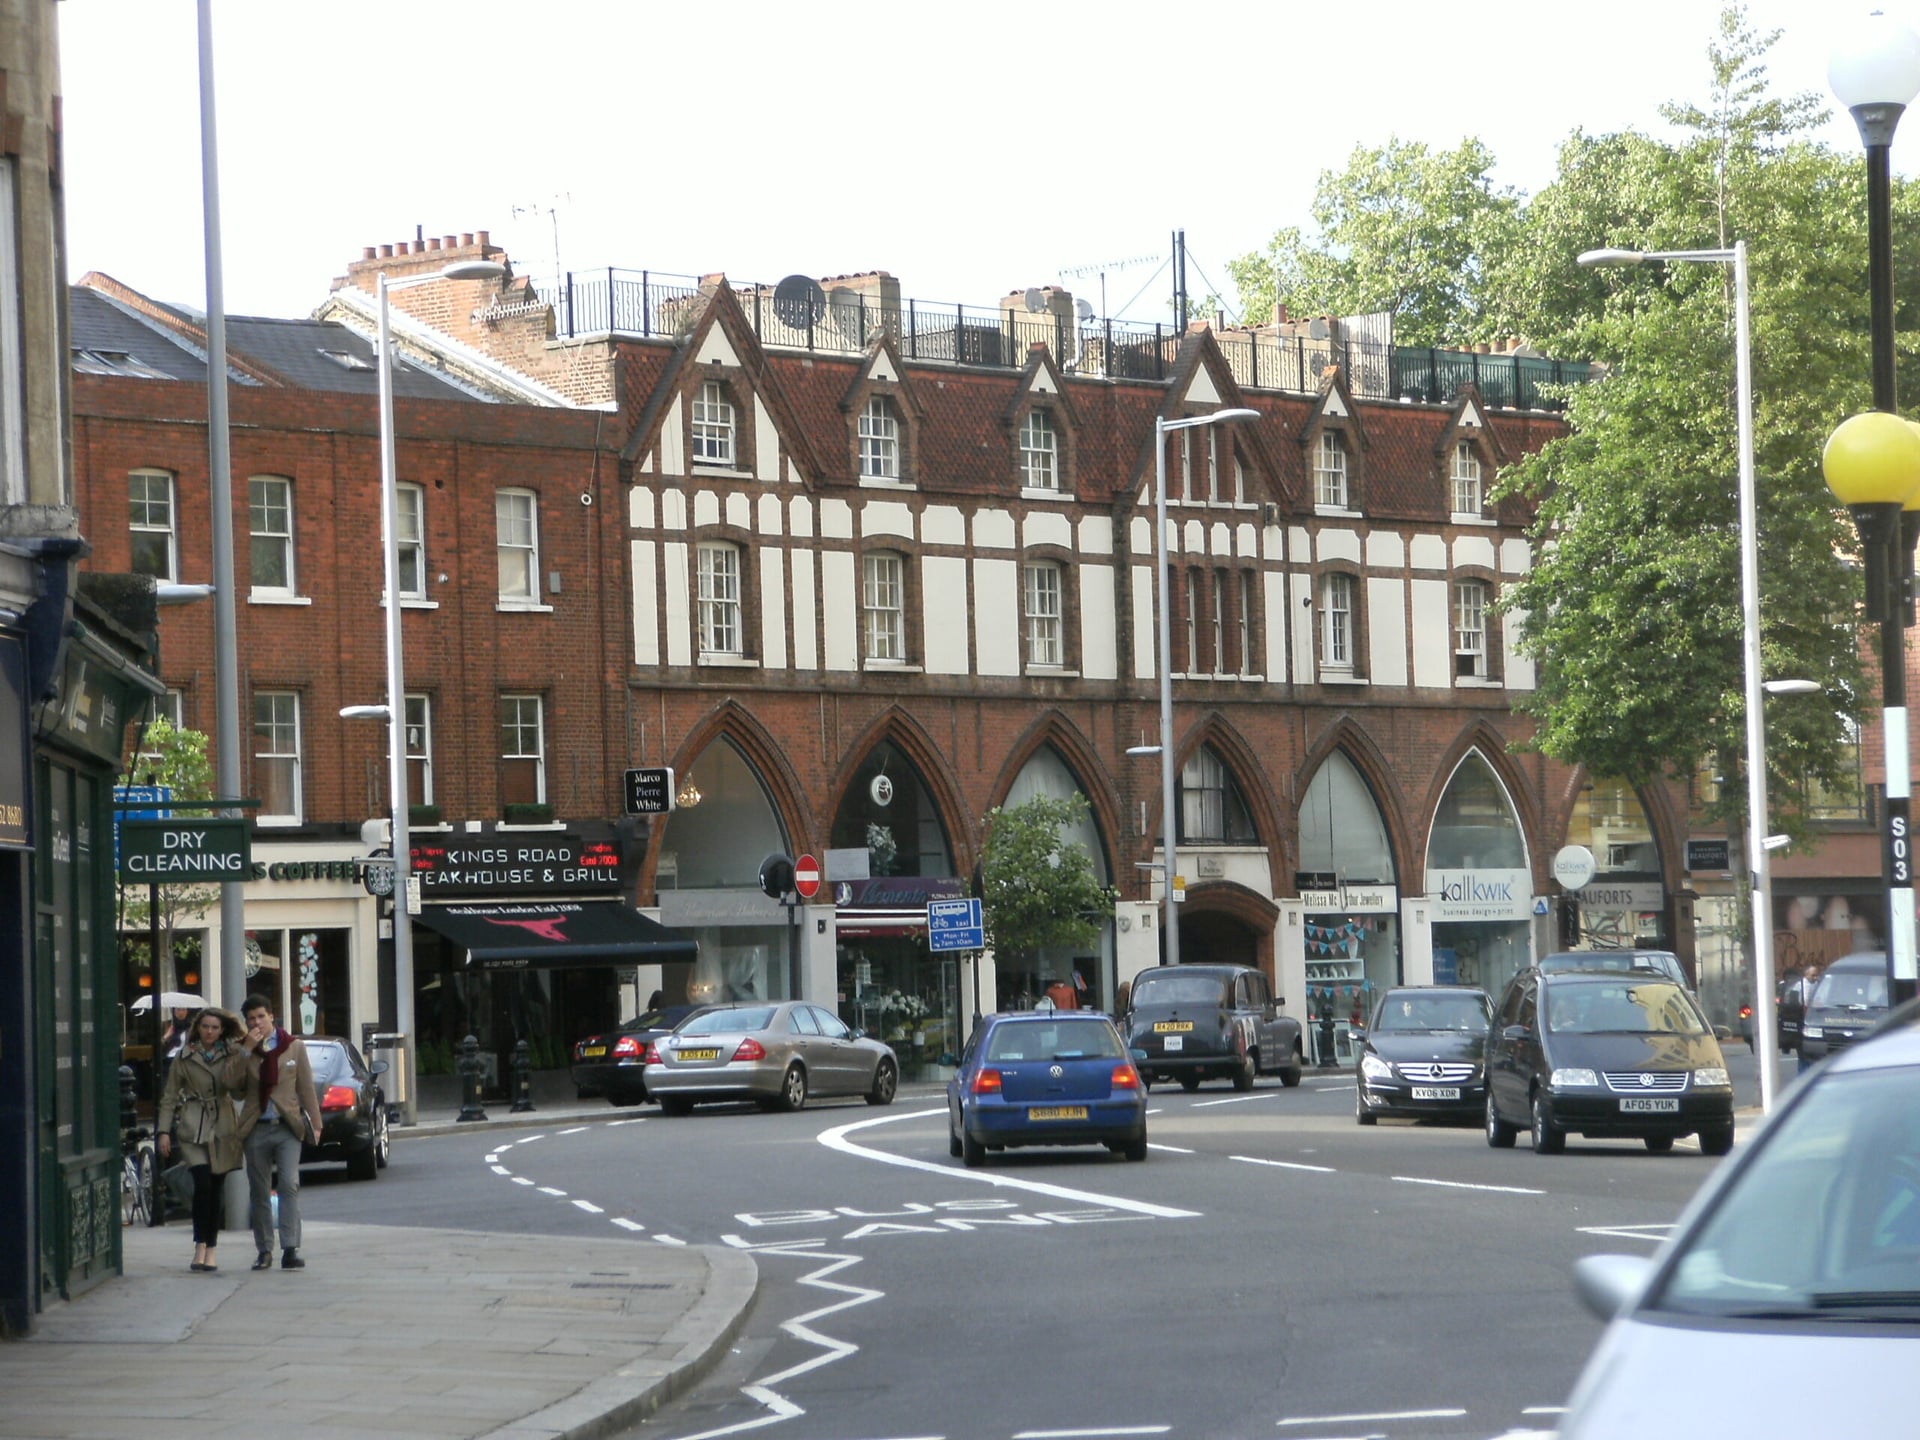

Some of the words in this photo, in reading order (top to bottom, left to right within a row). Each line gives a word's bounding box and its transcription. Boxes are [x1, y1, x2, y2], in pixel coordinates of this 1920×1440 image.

[634, 773, 660, 783] Marco
[636, 786, 661, 797] Pierre
[636, 799, 661, 810] White
[163, 832, 206, 849] DRY
[1892, 816, 1907, 881] S03
[128, 853, 242, 872] CLEANING
[448, 849, 508, 864] KINGS
[518, 848, 571, 863] ROAD
[269, 860, 357, 881] COFFEE
[413, 868, 534, 885] TEAKHOUSE
[542, 869, 555, 883] &
[563, 867, 618, 883] GRILL
[1304, 892, 1327, 906] Melissa
[1471, 908, 1492, 917] design
[1498, 908, 1513, 916] print
[1625, 1100, 1651, 1110] AF05
[1655, 1100, 1674, 1110] YUK
[734, 1199, 1019, 1226] BUS
[720, 1208, 1155, 1249] LANE
